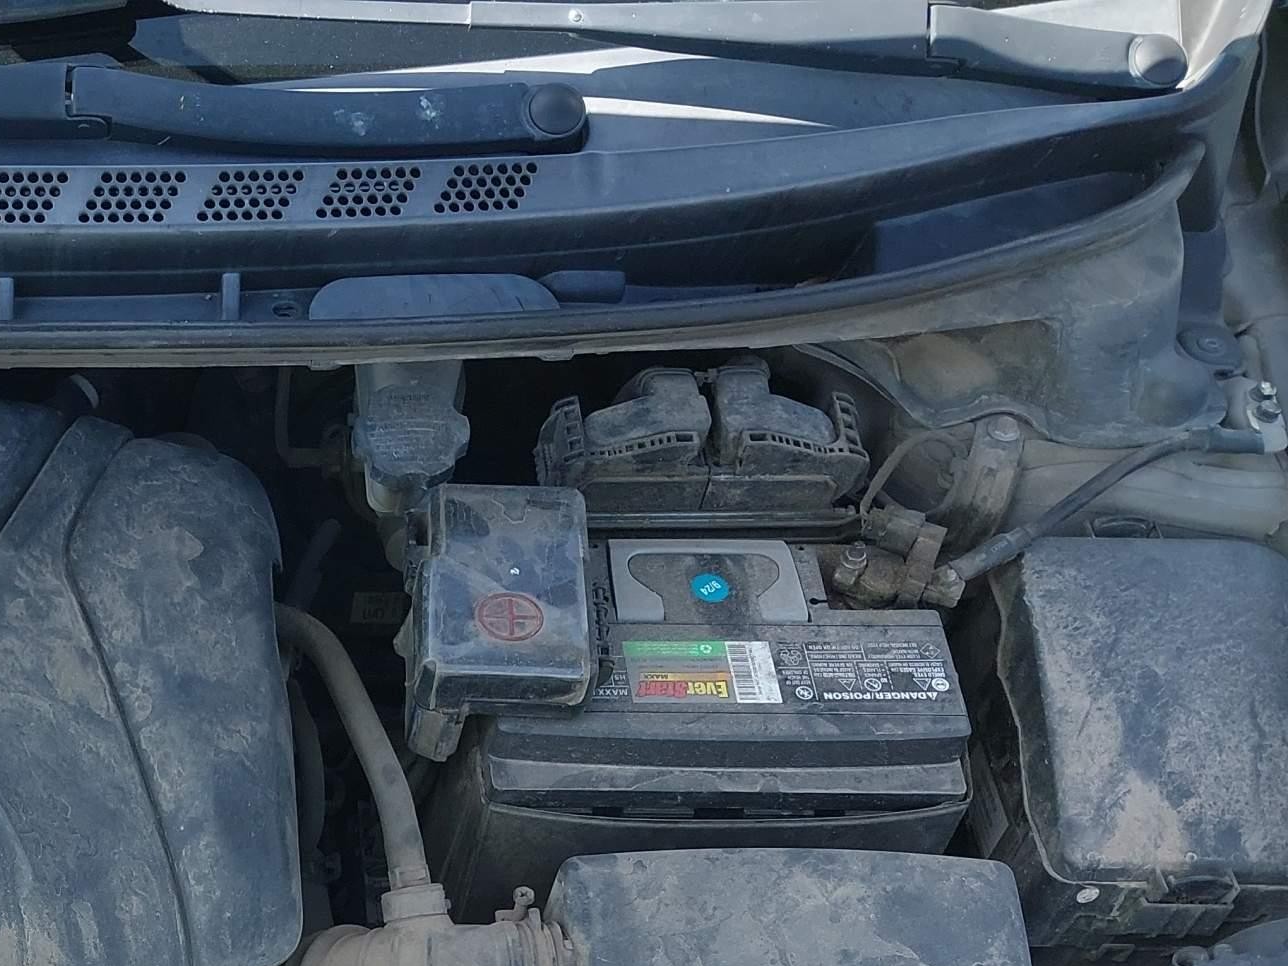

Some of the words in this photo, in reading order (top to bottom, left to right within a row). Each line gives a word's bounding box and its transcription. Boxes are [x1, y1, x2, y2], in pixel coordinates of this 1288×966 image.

[699, 579, 722, 596] 9/24
[597, 688, 628, 696] MAXX
[637, 680, 729, 698] EverStart
[824, 692, 927, 700] DANGER/POISON
